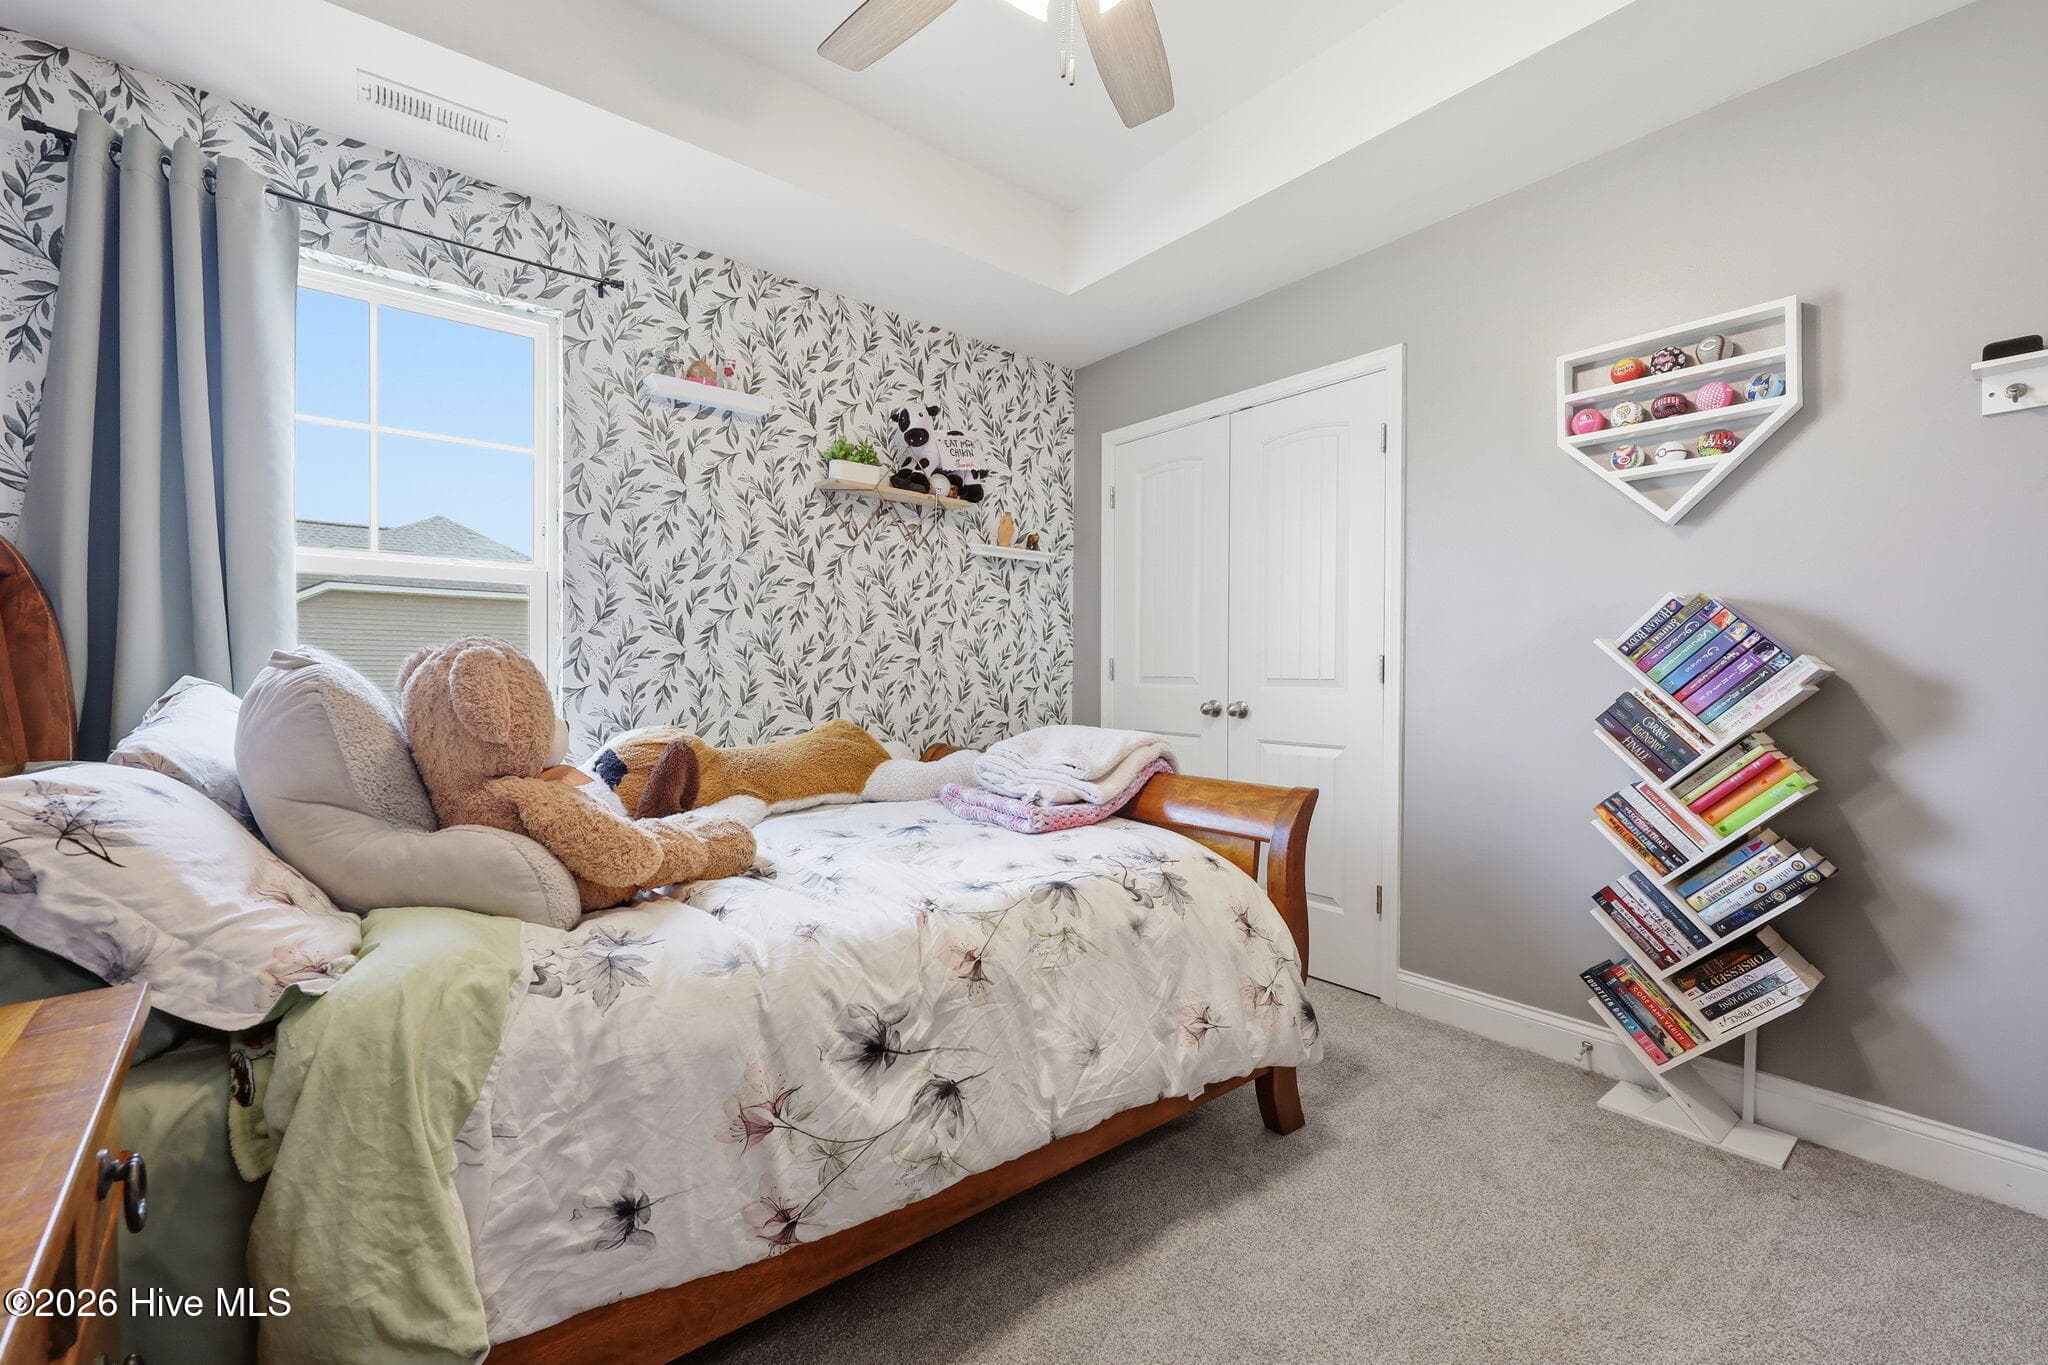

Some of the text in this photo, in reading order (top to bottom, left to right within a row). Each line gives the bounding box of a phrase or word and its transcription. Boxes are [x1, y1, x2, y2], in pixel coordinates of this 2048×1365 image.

[1641, 605, 1672, 634] HUMAN
[1624, 627, 1647, 650] BODY
[1621, 733, 1653, 763] FINALE
[1649, 831, 1669, 851] TRIALS
[1708, 951, 1764, 988] OBSESSED
[1582, 973, 1615, 1008] FOURTEEN
[1611, 1006, 1629, 1024] DAYS
[1631, 985, 1649, 1004] CODE
[1647, 1003, 1664, 1021] NAME
[1663, 1019, 1684, 1042] VERIFY
[1726, 995, 1776, 1026] CRUEL PRINCE
